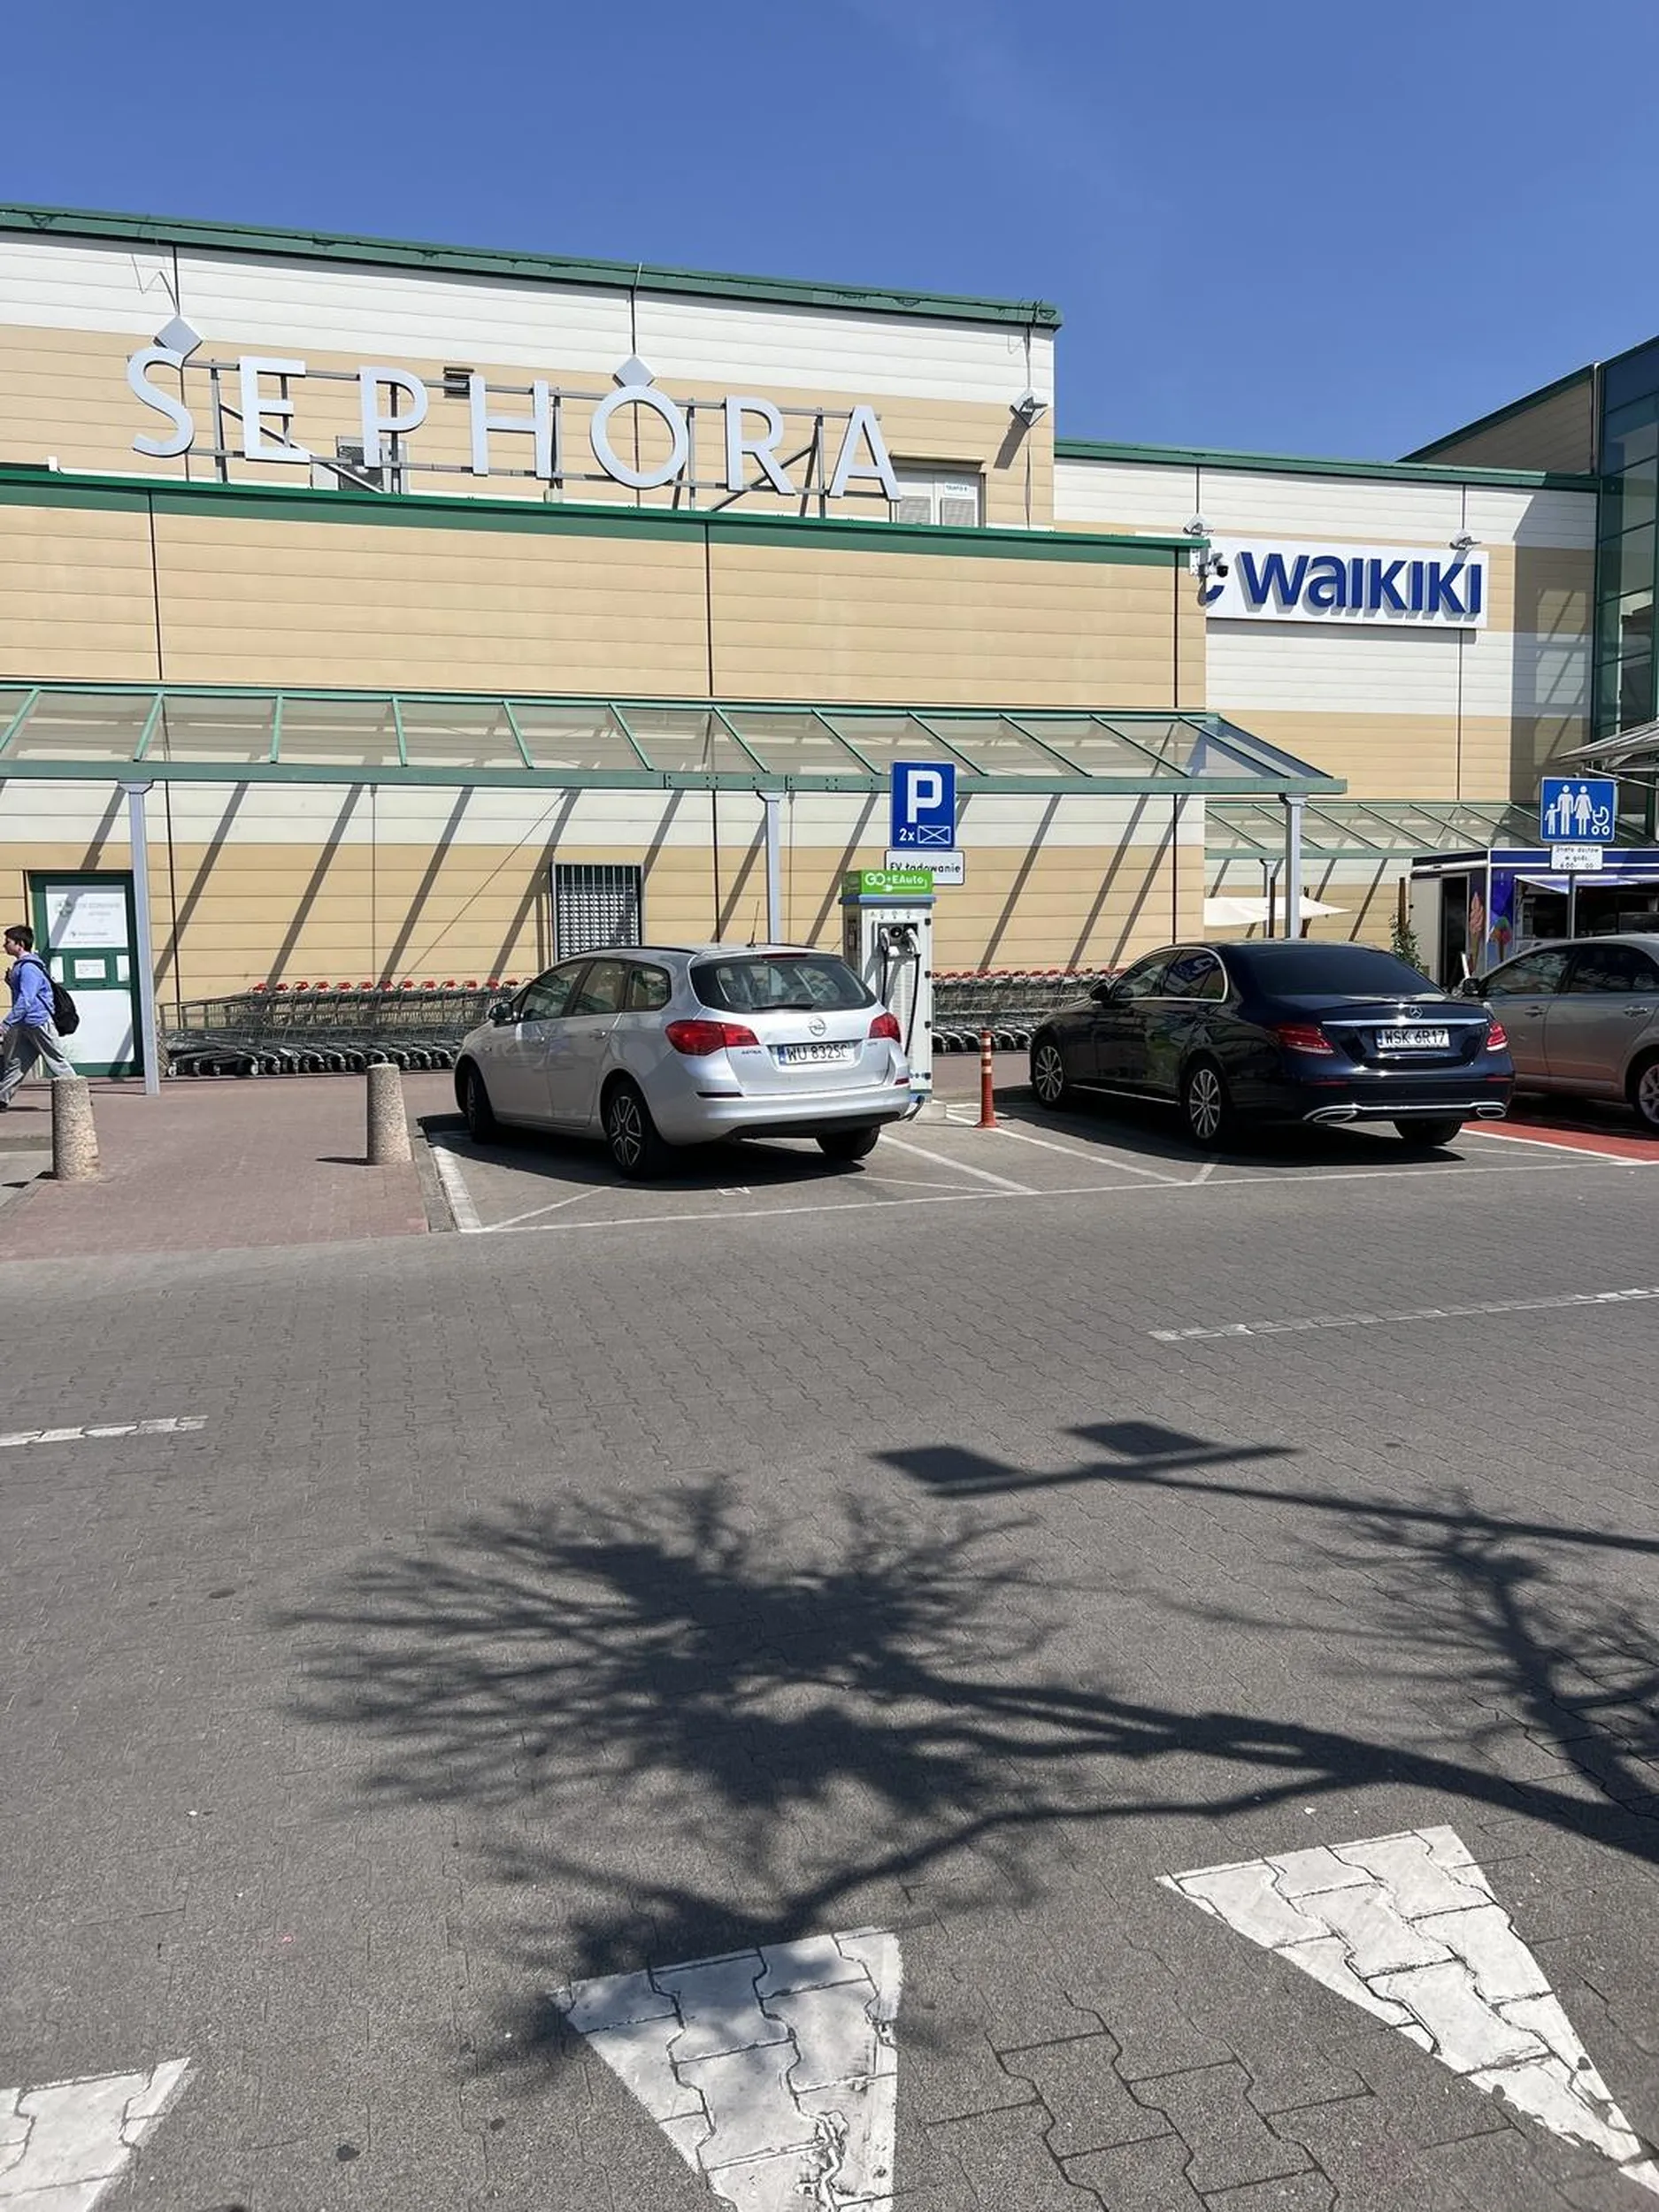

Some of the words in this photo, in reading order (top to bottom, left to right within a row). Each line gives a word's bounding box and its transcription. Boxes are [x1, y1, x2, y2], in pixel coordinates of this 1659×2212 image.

[127, 346, 902, 502] SEPHORA
[907, 770, 943, 823] P
[899, 828, 915, 841] 2x
[1385, 1030, 1409, 1044] WSK
[1415, 1030, 1446, 1044] 6R17
[786, 1046, 807, 1061] WU
